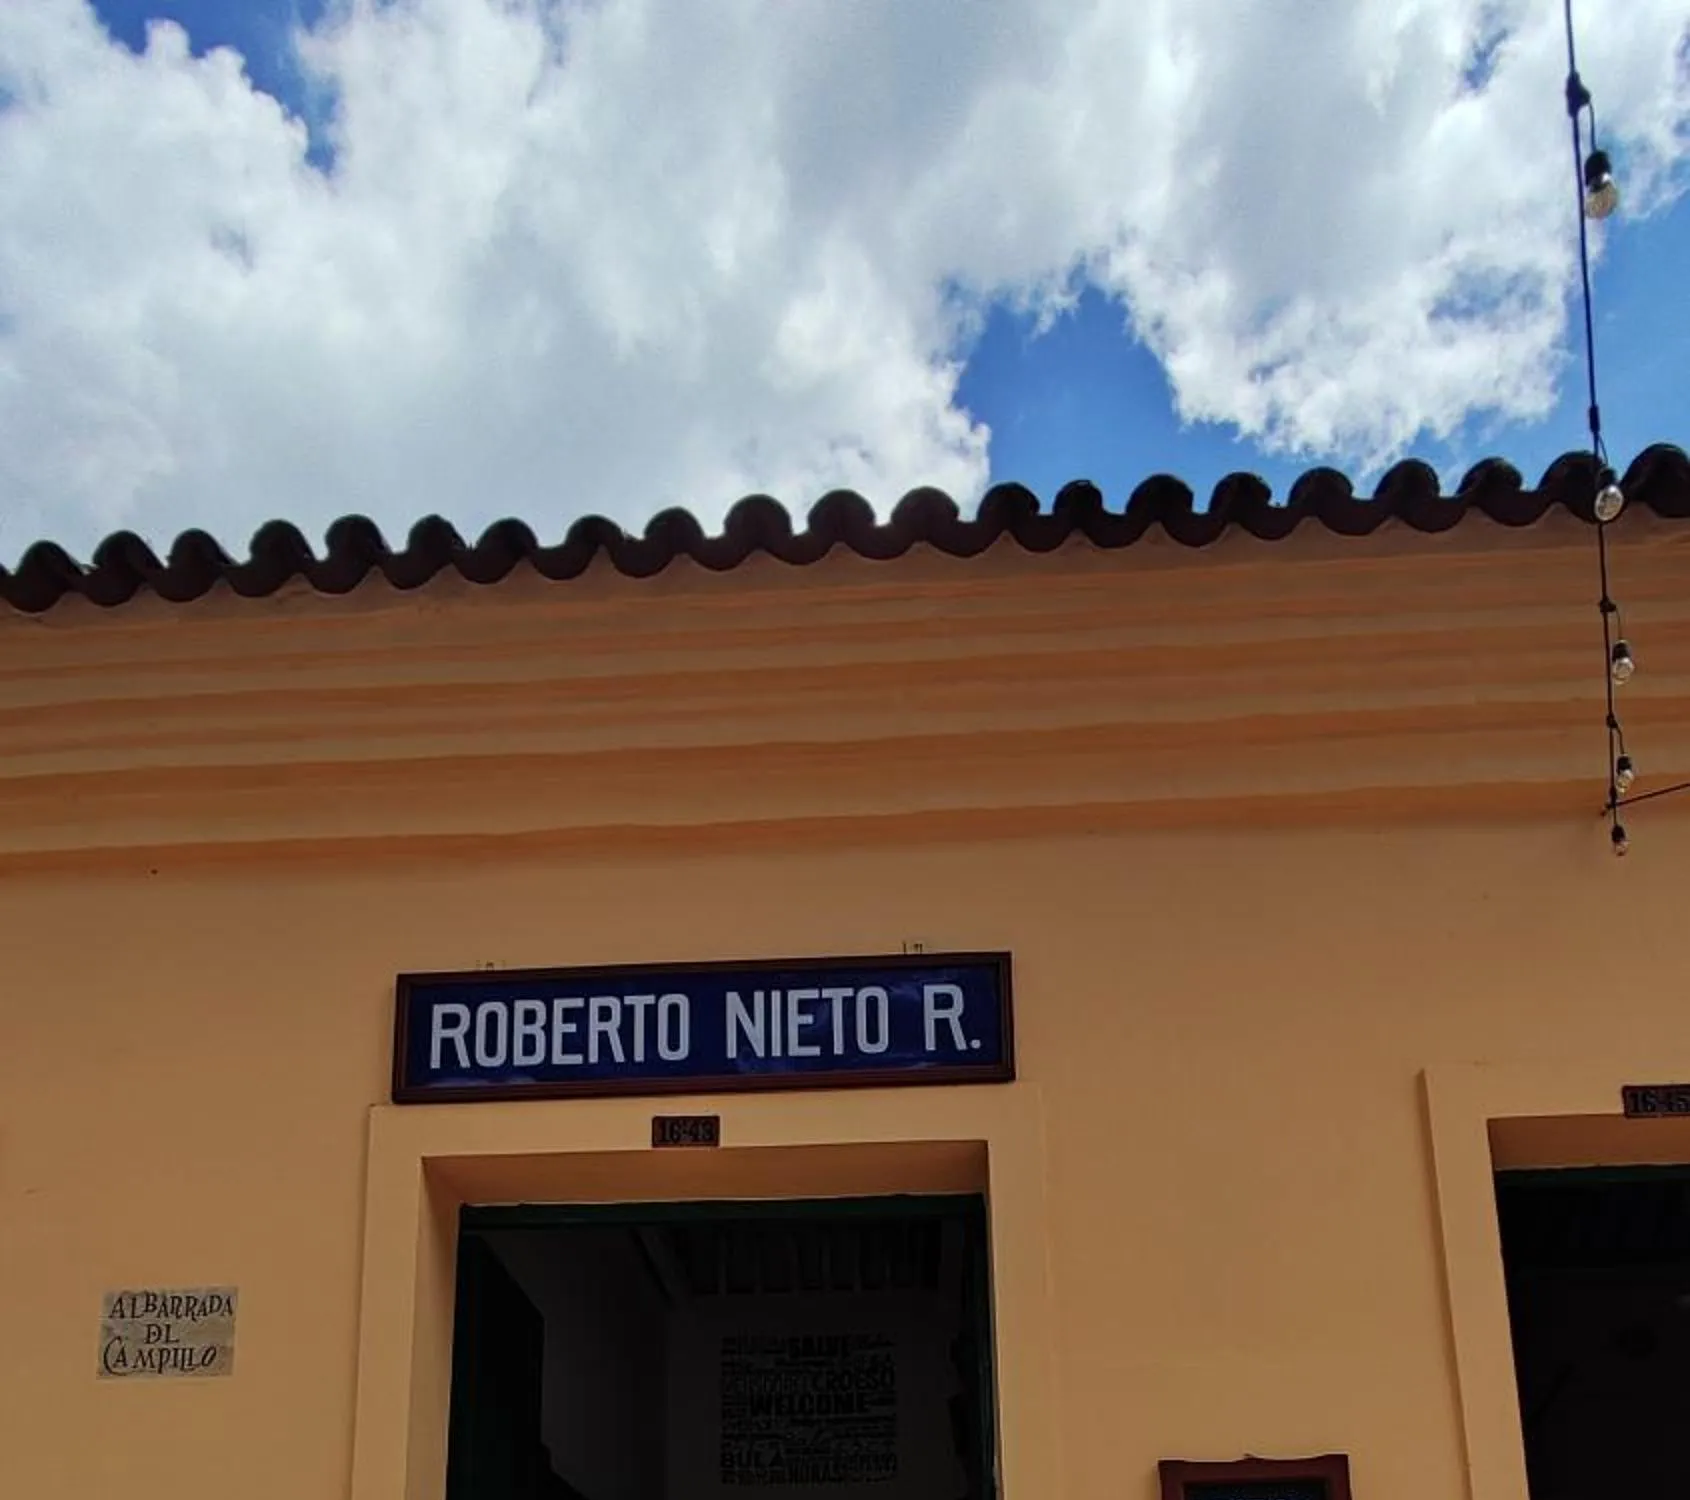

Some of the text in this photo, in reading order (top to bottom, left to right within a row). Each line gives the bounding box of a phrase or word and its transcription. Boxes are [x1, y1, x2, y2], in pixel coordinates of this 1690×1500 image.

[429, 983, 982, 1070] ROBERTO NIETO R.
[108, 1291, 234, 1322] ALBARRADA
[103, 1336, 218, 1376] CAMPILLO
